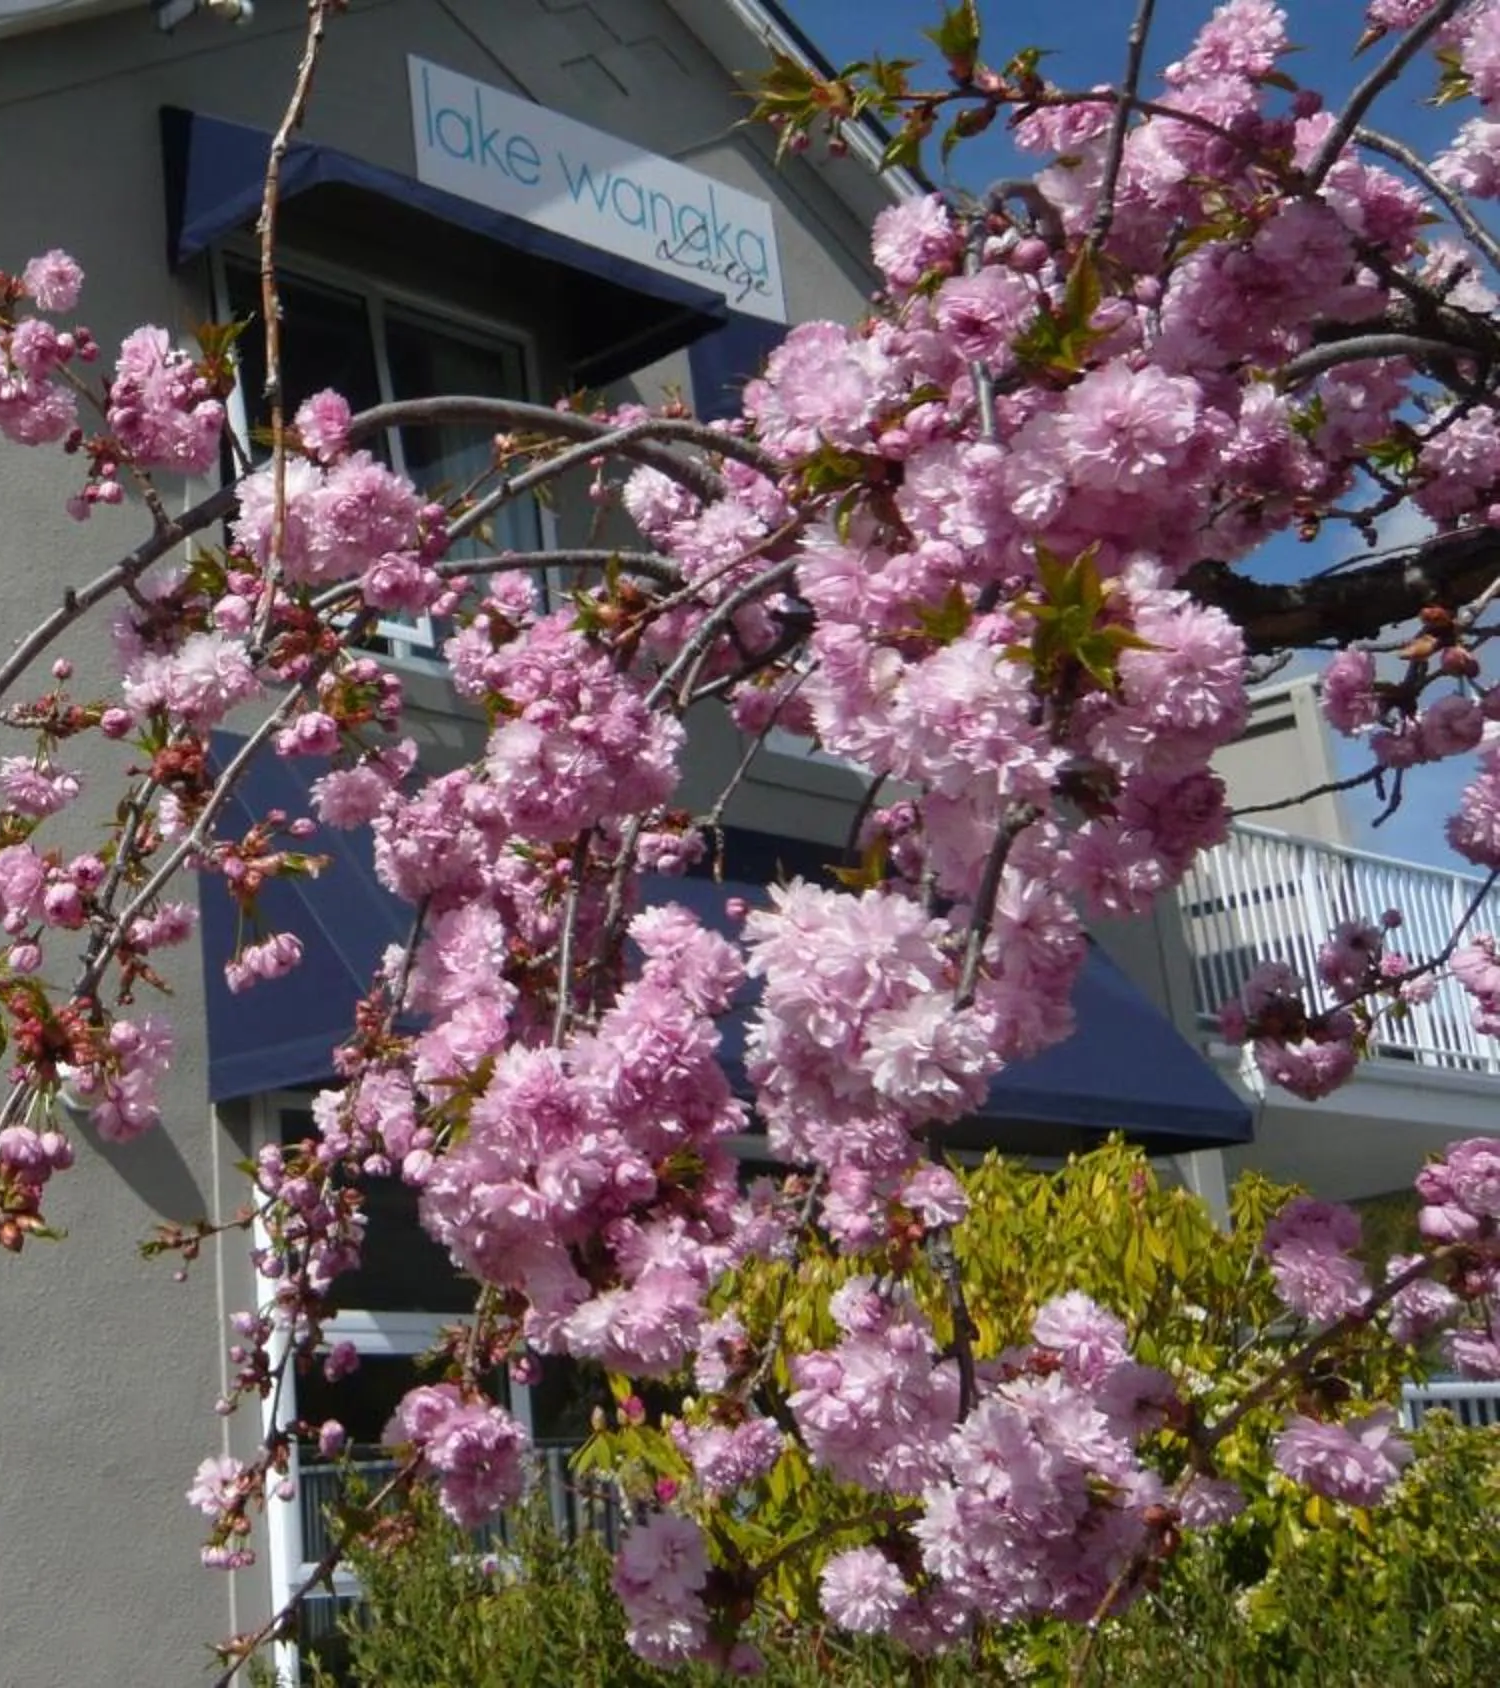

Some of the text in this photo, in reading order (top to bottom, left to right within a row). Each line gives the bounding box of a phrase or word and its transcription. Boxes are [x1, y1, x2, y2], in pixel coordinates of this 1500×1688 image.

[421, 66, 769, 279] lake wanaka
[656, 223, 773, 303] Lodge
